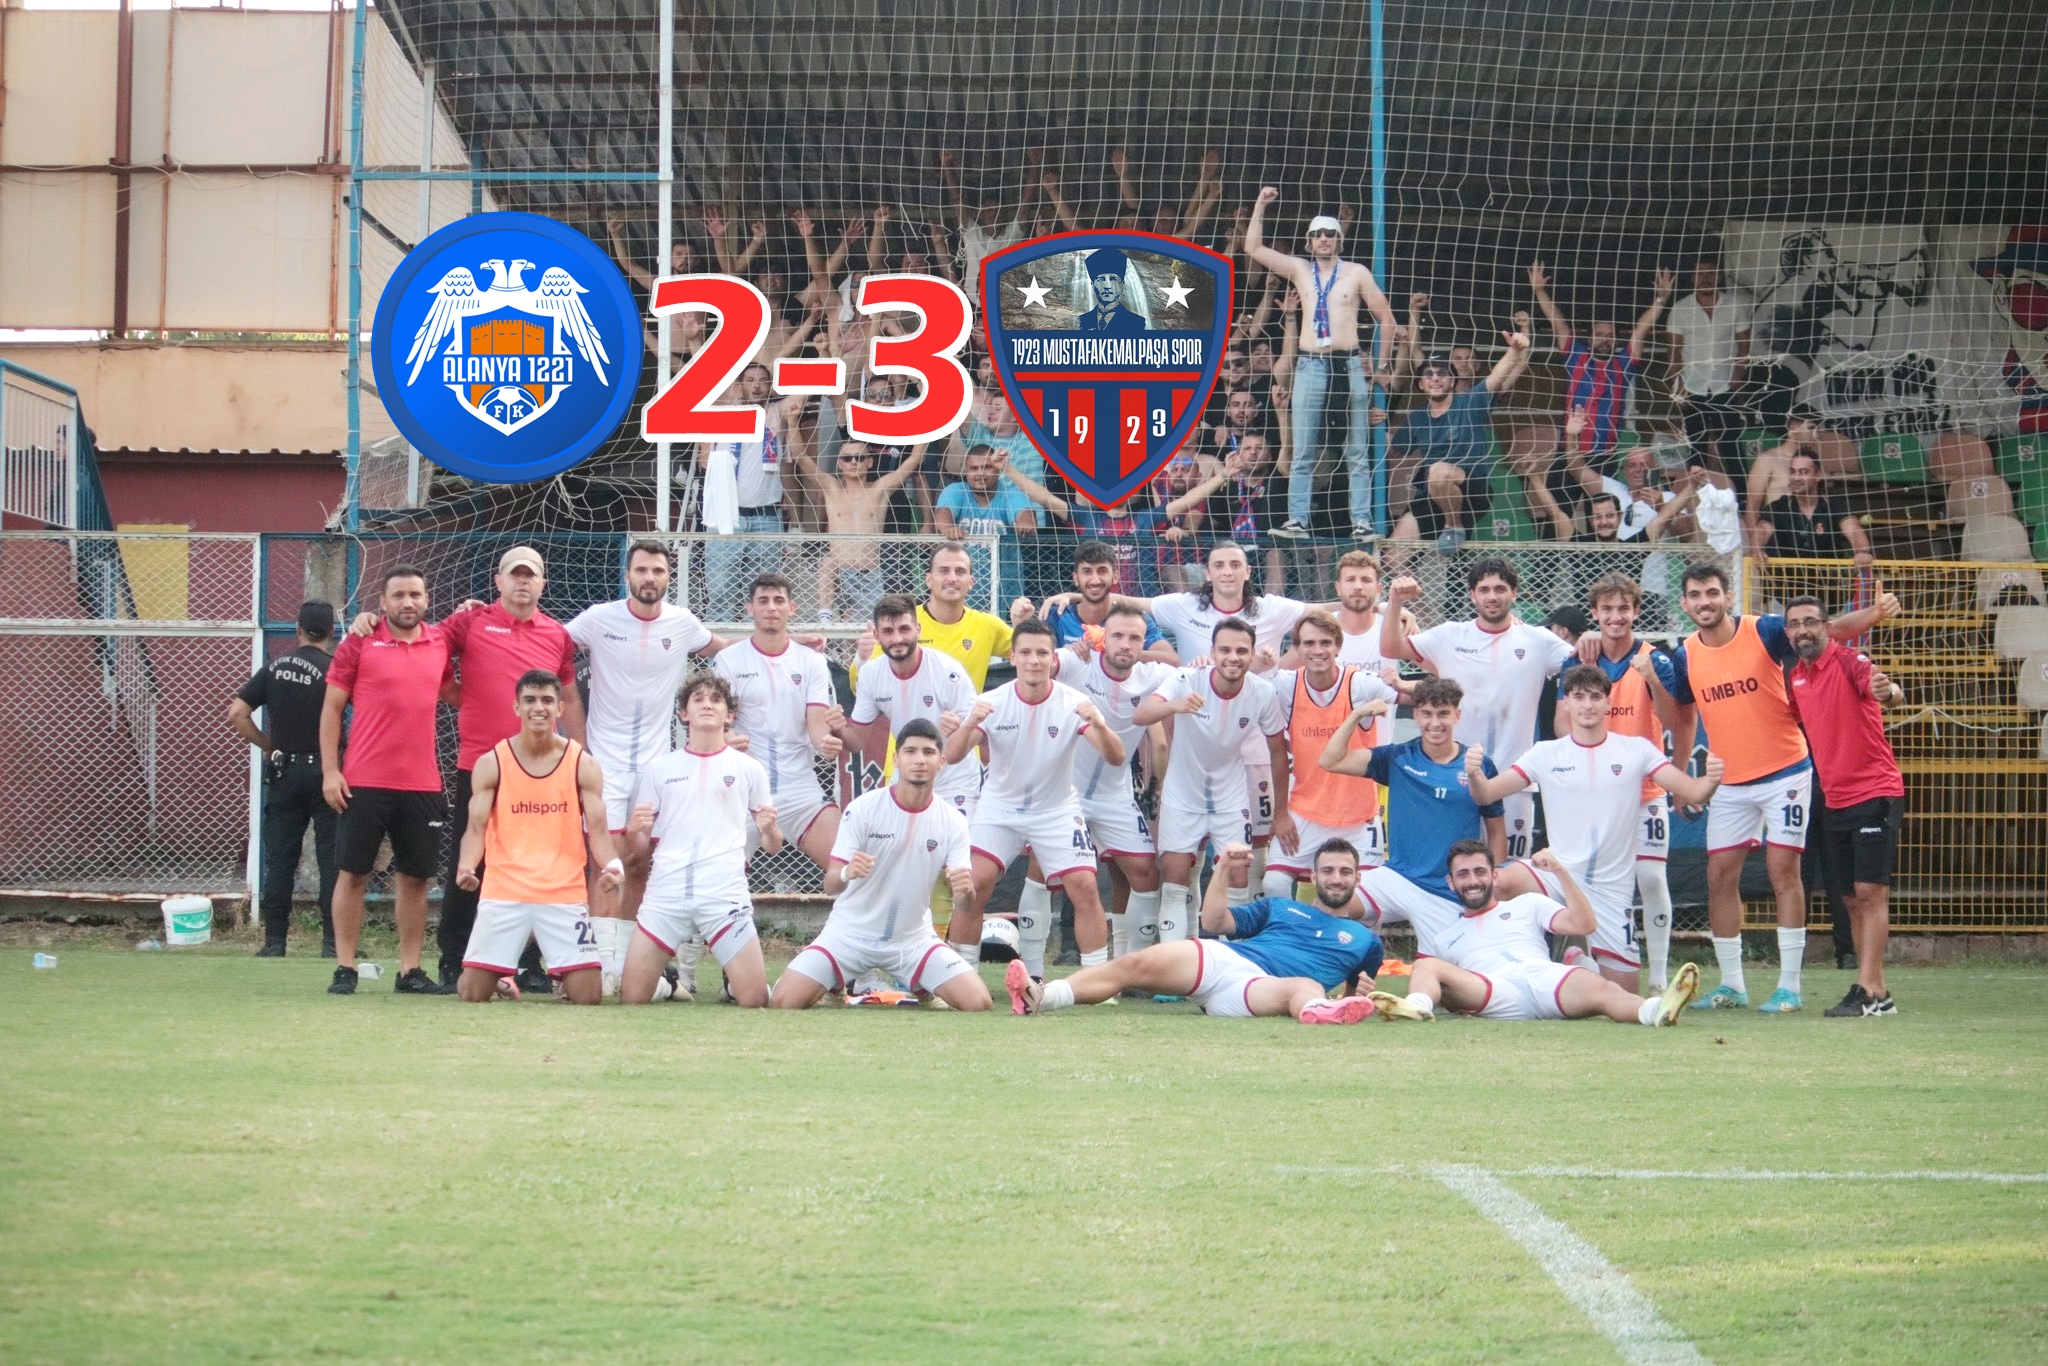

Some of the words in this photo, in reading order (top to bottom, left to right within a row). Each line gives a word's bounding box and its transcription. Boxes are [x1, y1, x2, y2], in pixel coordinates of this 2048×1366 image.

[484, 625, 512, 634] uhlsport
[603, 633, 628, 642] uhlsport
[292, 656, 322, 680] KUVVET
[1701, 676, 1758, 703] UMBRO
[995, 723, 1019, 731] uhlsport
[1434, 787, 1447, 799] 17
[511, 800, 568, 816] uhlsport
[1259, 796, 1272, 818] 5
[1782, 804, 1804, 827] 19
[868, 832, 894, 840] uhlsport
[1644, 818, 1665, 840] 18
[1506, 834, 1526, 858] 10
